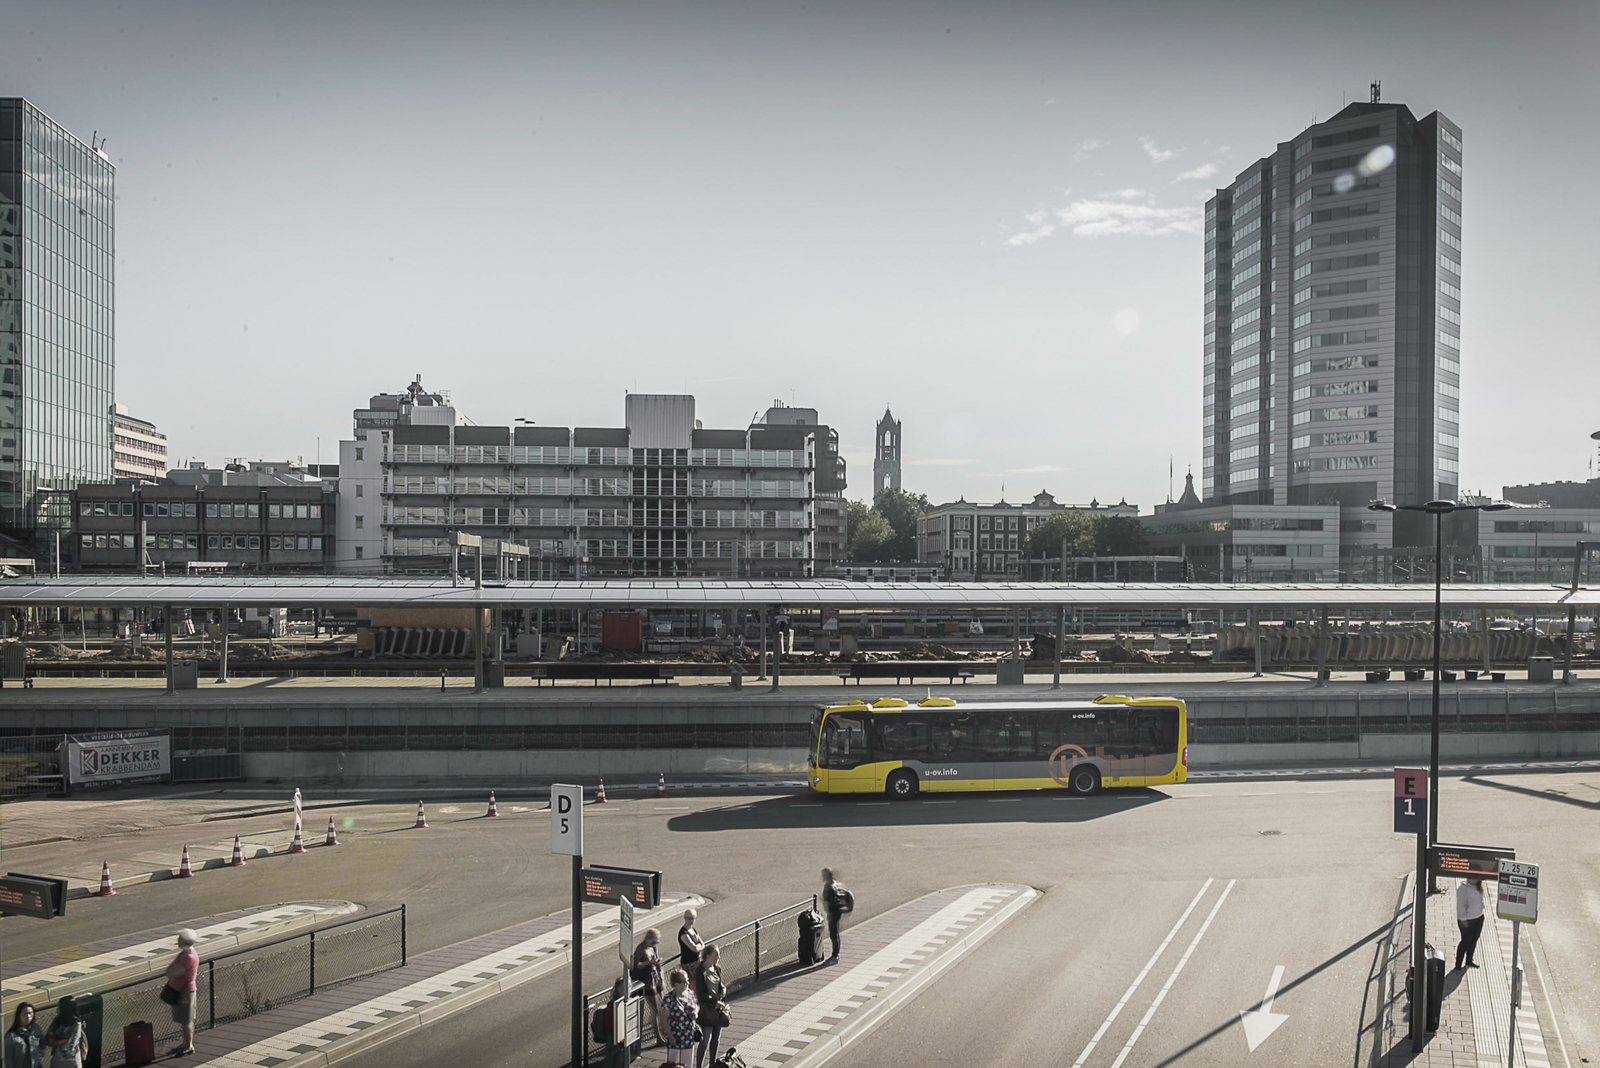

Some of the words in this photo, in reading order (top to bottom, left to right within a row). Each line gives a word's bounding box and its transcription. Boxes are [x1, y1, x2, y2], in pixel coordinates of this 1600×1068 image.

[101, 750, 160, 765] DEKKER
[101, 761, 160, 774] KRABBENDAM
[924, 767, 958, 776] u-ov.info
[1404, 777, 1416, 795] E
[558, 795, 572, 814] D
[1404, 798, 1416, 815] 1
[561, 818, 569, 834] 5
[1512, 864, 1521, 873] 25
[1527, 866, 1536, 876] 26
